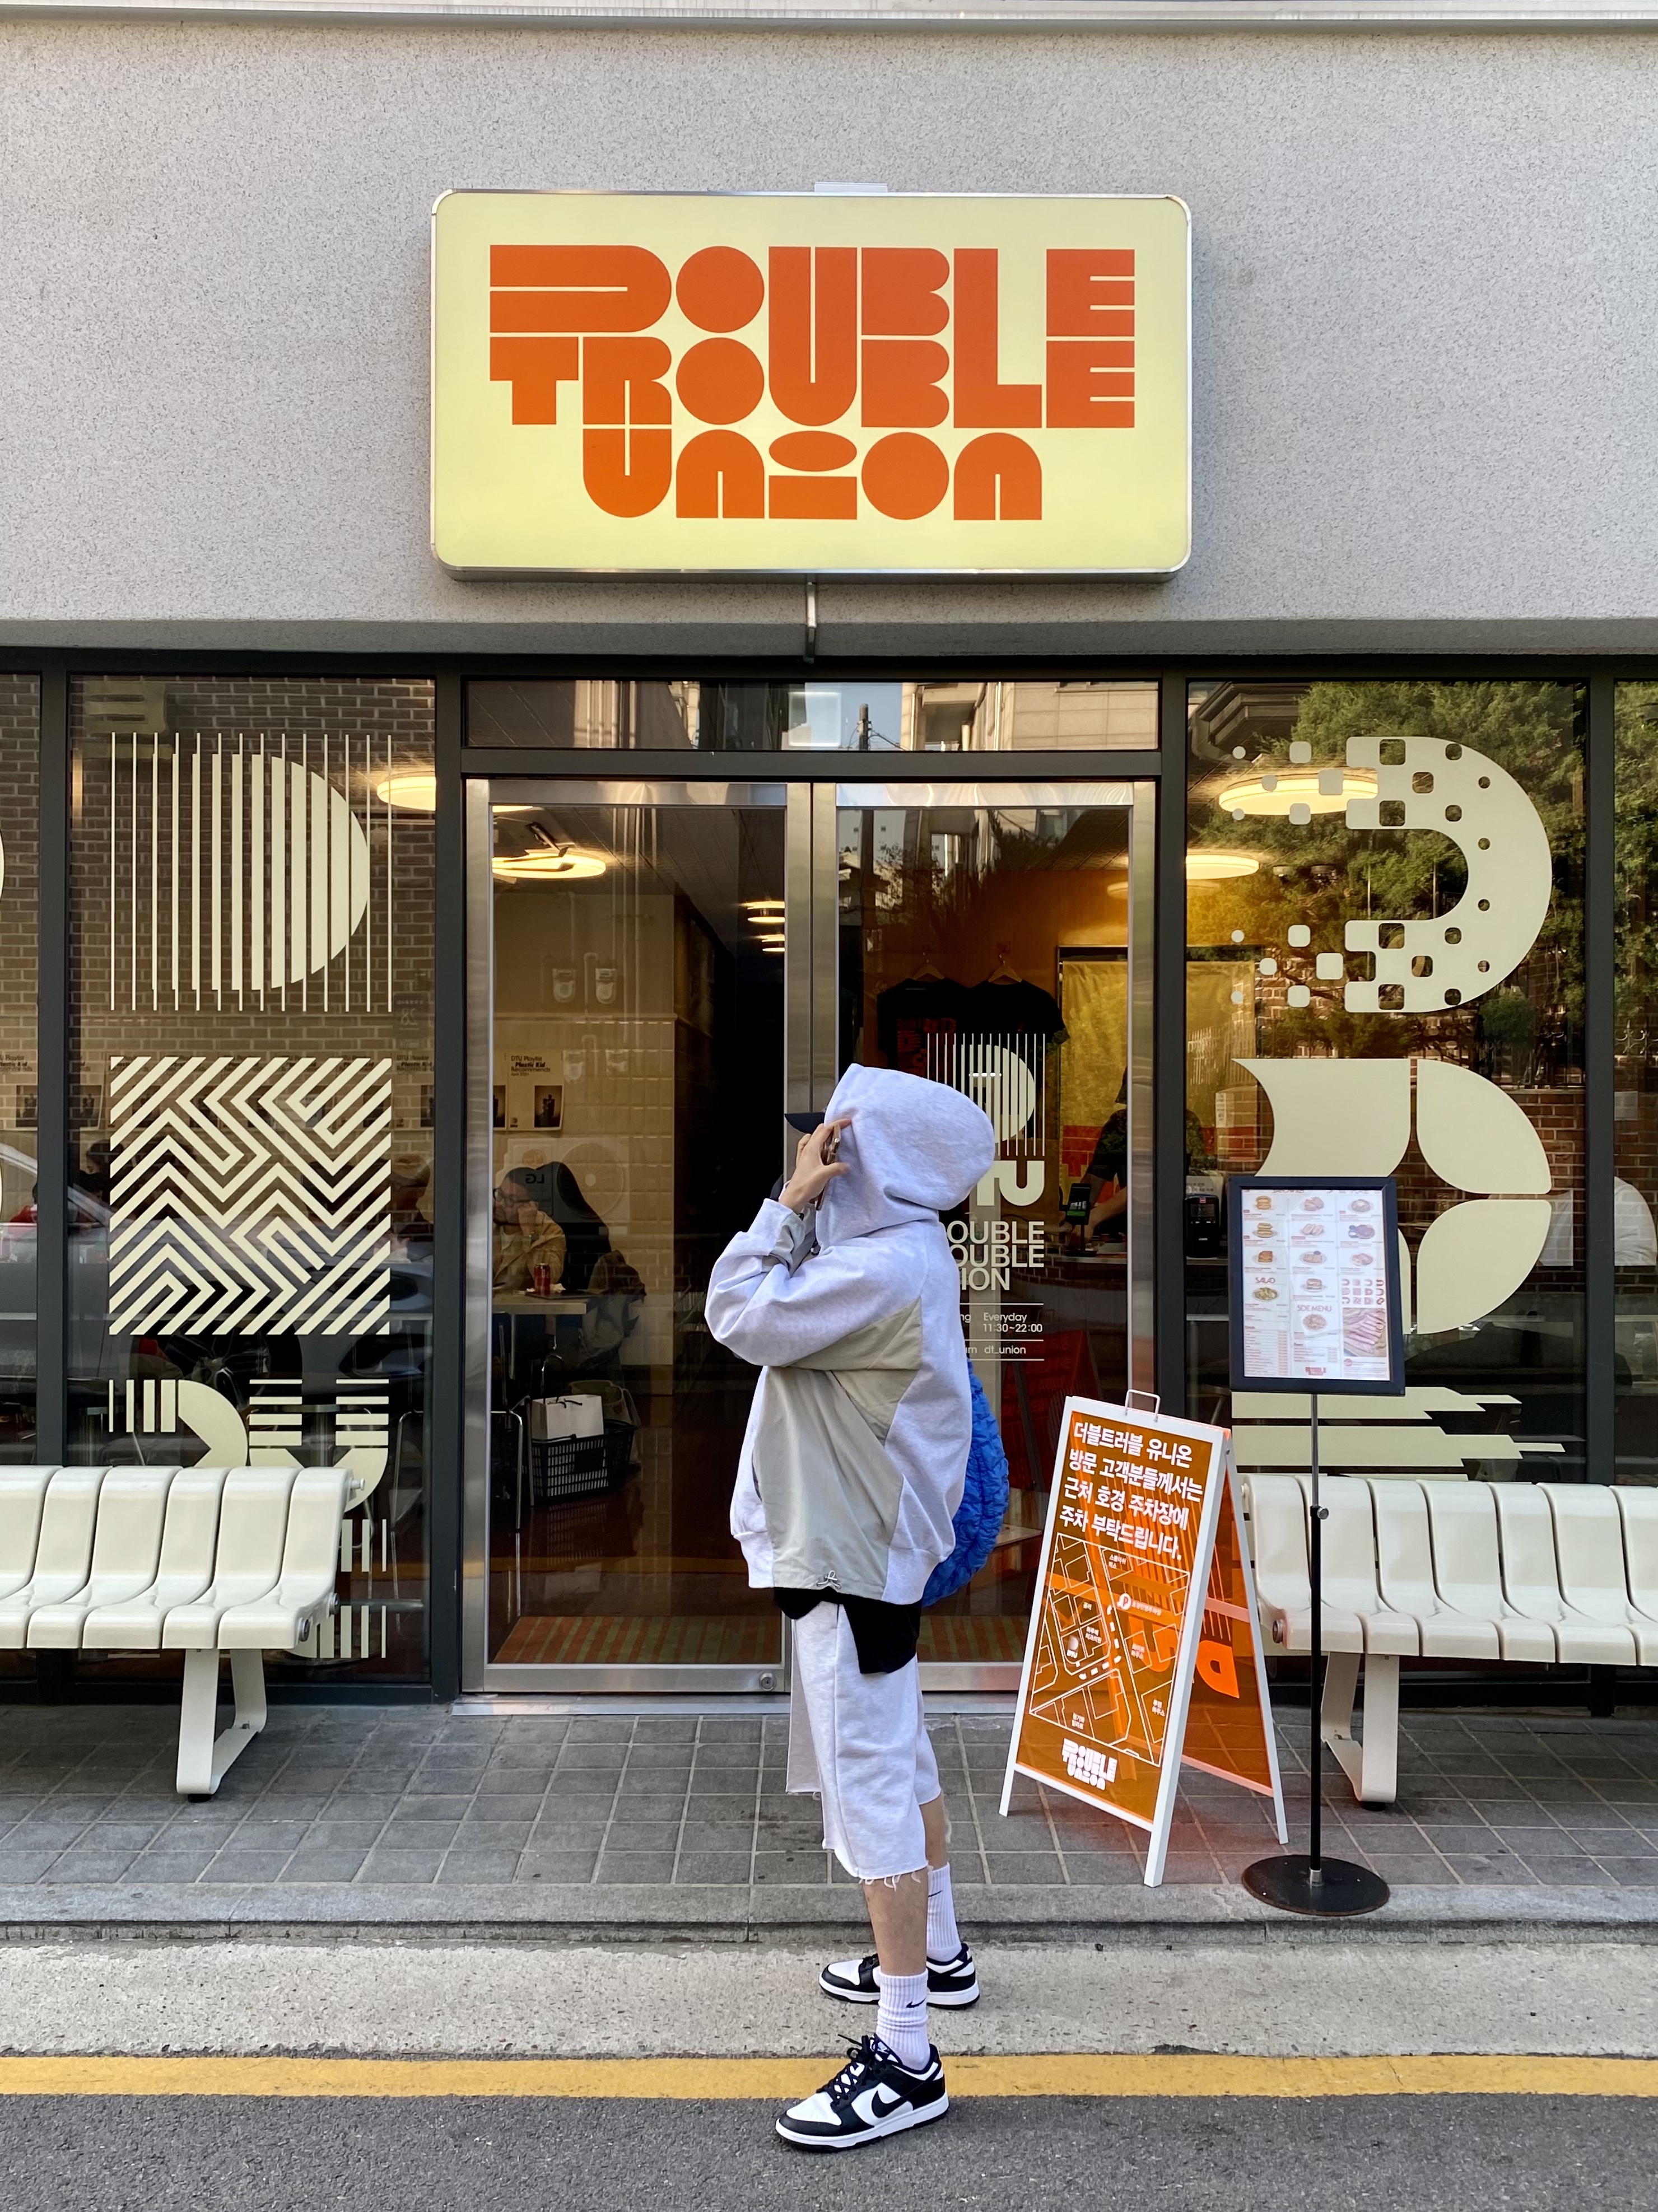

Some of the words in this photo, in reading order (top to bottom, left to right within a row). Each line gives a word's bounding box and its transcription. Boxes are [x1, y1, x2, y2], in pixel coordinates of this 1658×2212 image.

[490, 245, 1135, 337] DOUBLE
[490, 337, 1135, 428] TROUBLE
[583, 429, 1042, 520] UNION
[977, 1160, 1045, 1206] TU
[947, 1220, 1045, 1244] OUBLE
[950, 1244, 1045, 1267] OUBLE
[961, 1267, 1010, 1291] ION
[982, 1323, 1043, 1333] 11:30~22:00
[983, 1312, 1027, 1323] Everyday
[984, 1345, 1027, 1354] dt_union
[1074, 1422, 1143, 1457] 더블트러블
[1147, 1438, 1192, 1468] 유니온
[1069, 1448, 1097, 1474] 방문
[1099, 1458, 1203, 1503] 고객분들께서는
[1064, 1477, 1093, 1504] 근처
[1095, 1486, 1125, 1513] 호경
[1128, 1494, 1189, 1530] 주차장에
[1059, 1505, 1088, 1532] 주차
[1091, 1514, 1182, 1561] 부탁드립니다.
